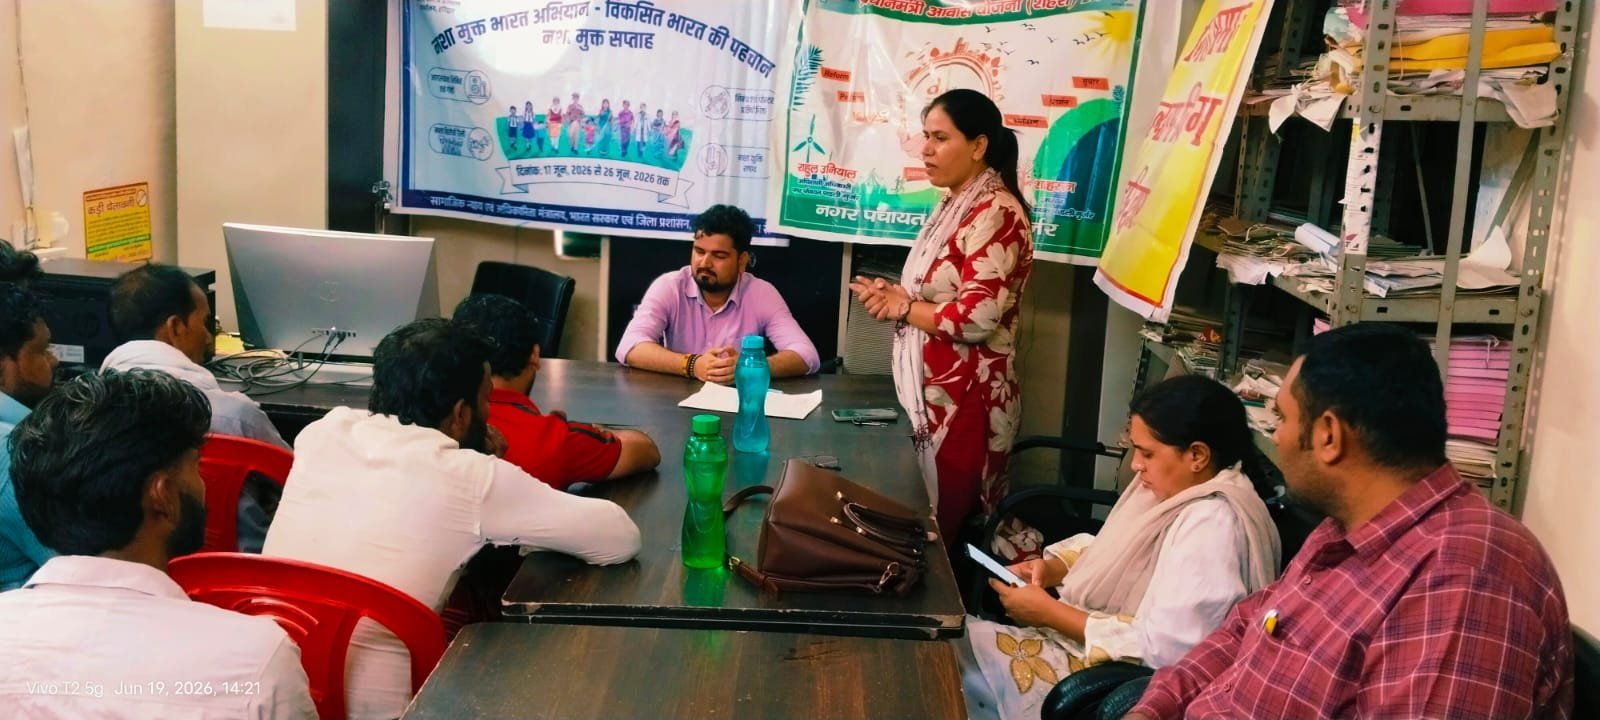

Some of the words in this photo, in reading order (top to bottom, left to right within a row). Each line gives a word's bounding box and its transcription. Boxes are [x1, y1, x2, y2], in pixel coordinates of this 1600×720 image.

[431, 27, 455, 54] नशा
[456, 18, 486, 44] मुक्त
[491, 11, 529, 31] भारत
[533, 1, 590, 24] अभियान
[605, 0, 665, 26] विकसित
[667, 13, 707, 40] भारत
[708, 26, 730, 51] की
[730, 37, 776, 78] पहचान
[576, 28, 606, 51] मुक्त
[609, 30, 655, 49] सप्ताह
[571, 165, 592, 175] 2026
[594, 164, 602, 175] से
[603, 167, 614, 176] 26
[634, 171, 655, 183] 2026
[656, 175, 670, 186] तक
[820, 163, 858, 179] उनियाल
[591, 213, 619, 224] सरकार
[636, 213, 657, 227] जिला
[659, 217, 692, 230] प्रशासन,
[816, 205, 859, 220] नगर
